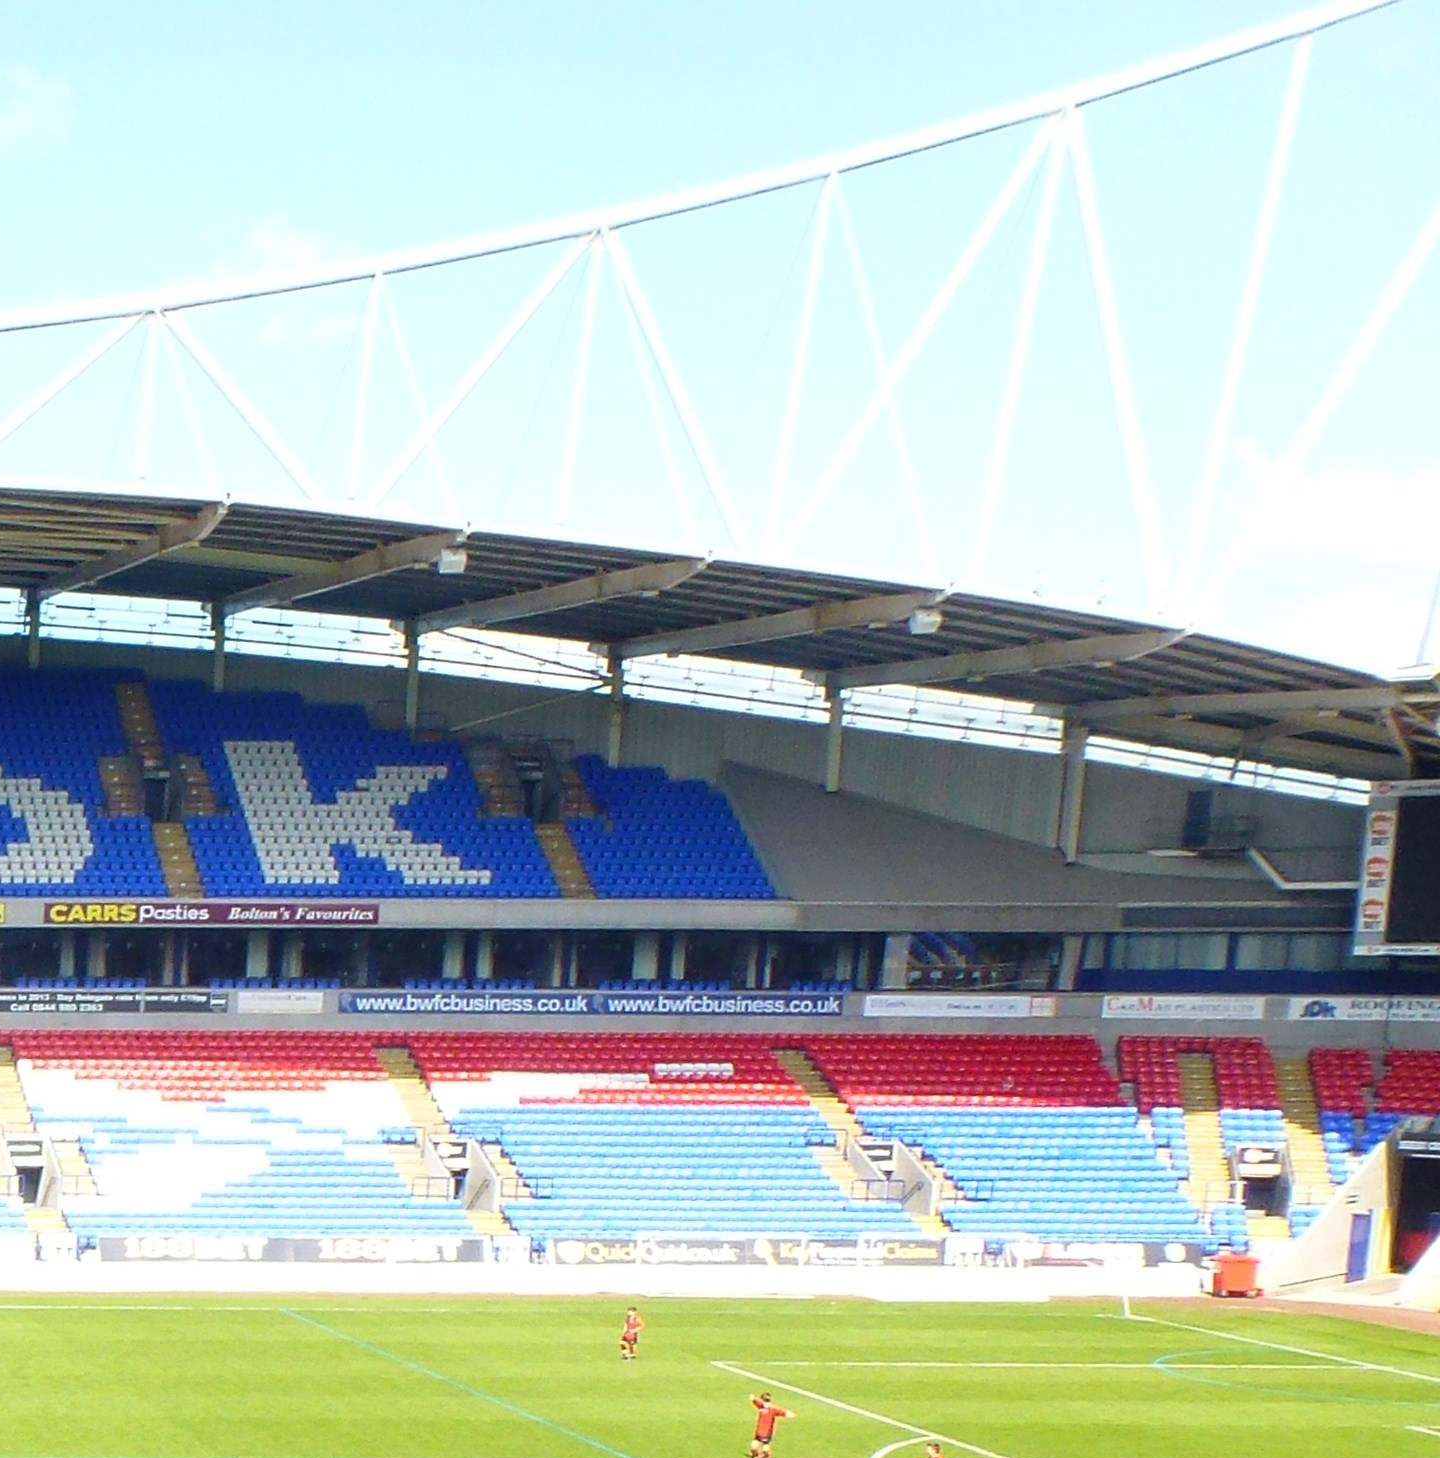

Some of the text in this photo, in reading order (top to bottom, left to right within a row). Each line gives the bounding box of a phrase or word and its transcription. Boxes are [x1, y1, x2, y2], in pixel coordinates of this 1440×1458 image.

[50, 904, 374, 922] CARRS Pasties Bolton's Favourites
[356, 994, 588, 1011] www.bwfcbusiness.co.uk
[607, 995, 840, 1013] www.bwfcbusiness.co.uk
